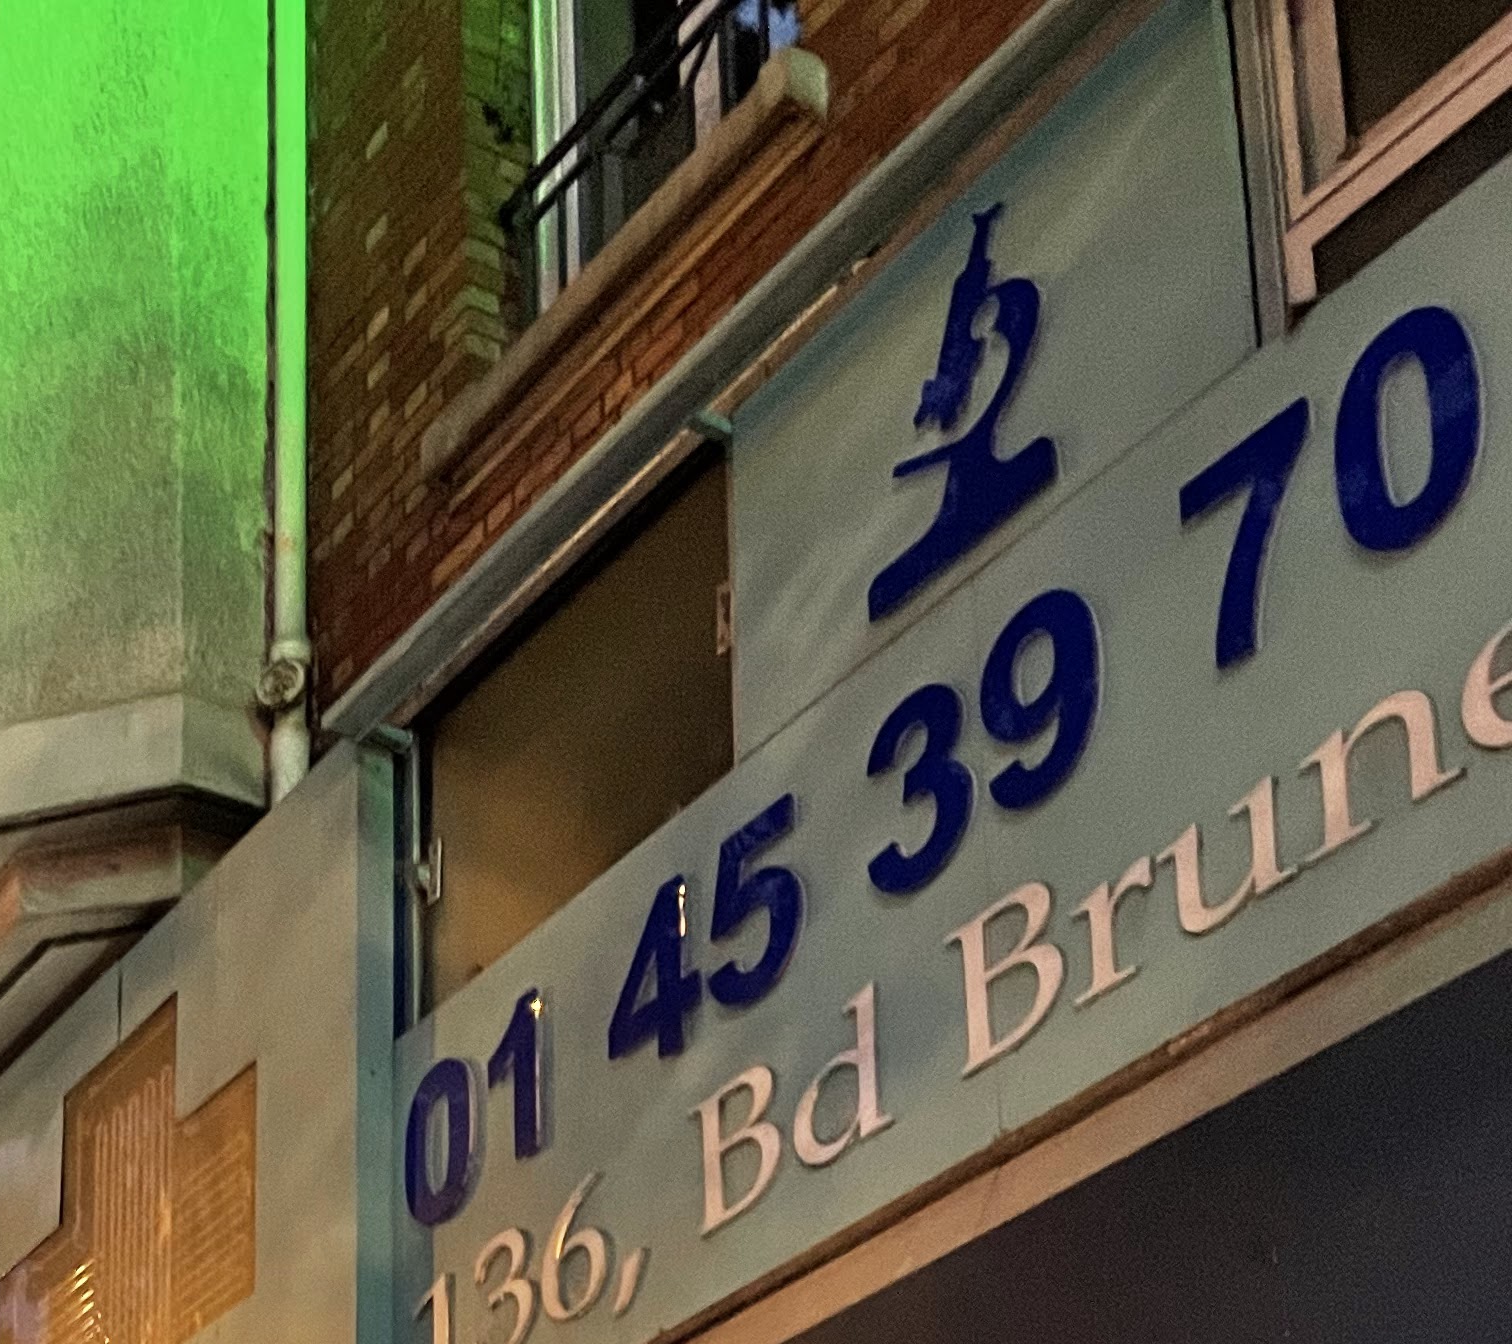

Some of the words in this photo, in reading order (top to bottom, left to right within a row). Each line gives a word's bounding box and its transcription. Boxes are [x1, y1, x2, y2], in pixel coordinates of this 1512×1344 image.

[403, 991, 554, 1226] 01
[607, 791, 801, 1060] 45
[865, 589, 1102, 895] 39
[1179, 305, 1481, 668] 70
[692, 988, 893, 1237] Bd
